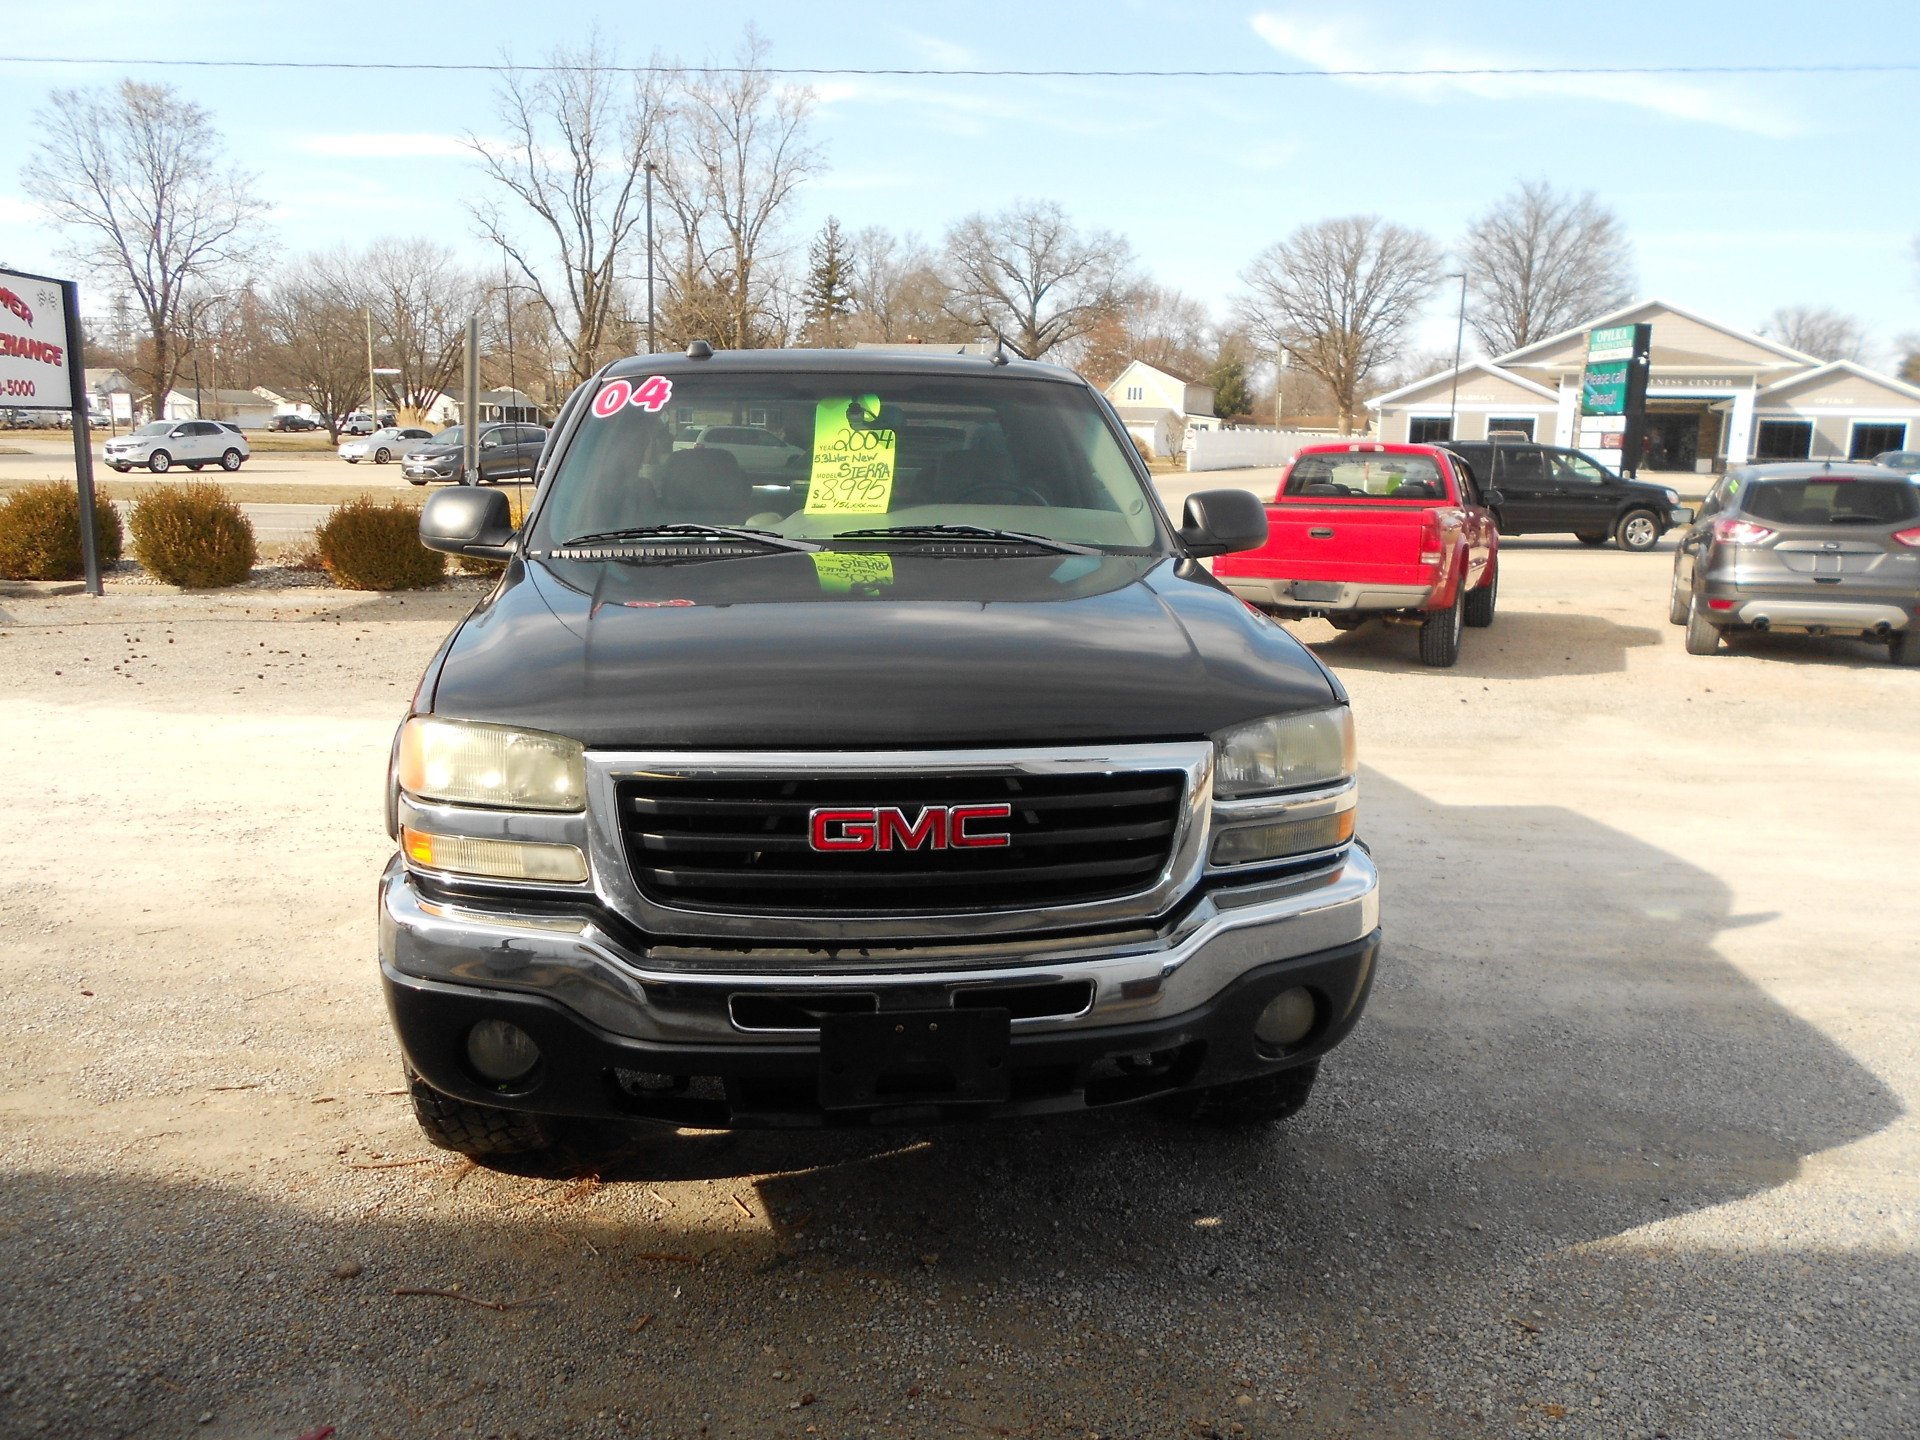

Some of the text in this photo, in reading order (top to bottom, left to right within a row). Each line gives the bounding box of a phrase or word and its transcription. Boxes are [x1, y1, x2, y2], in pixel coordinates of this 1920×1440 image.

[1584, 368, 1626, 385] Please call
[0, 379, 35, 396] -5000
[592, 376, 673, 418] 04
[1589, 390, 1616, 406] ahead!
[833, 428, 894, 452] 2004
[838, 462, 890, 480] SIERRA
[808, 803, 1011, 851] GMC
